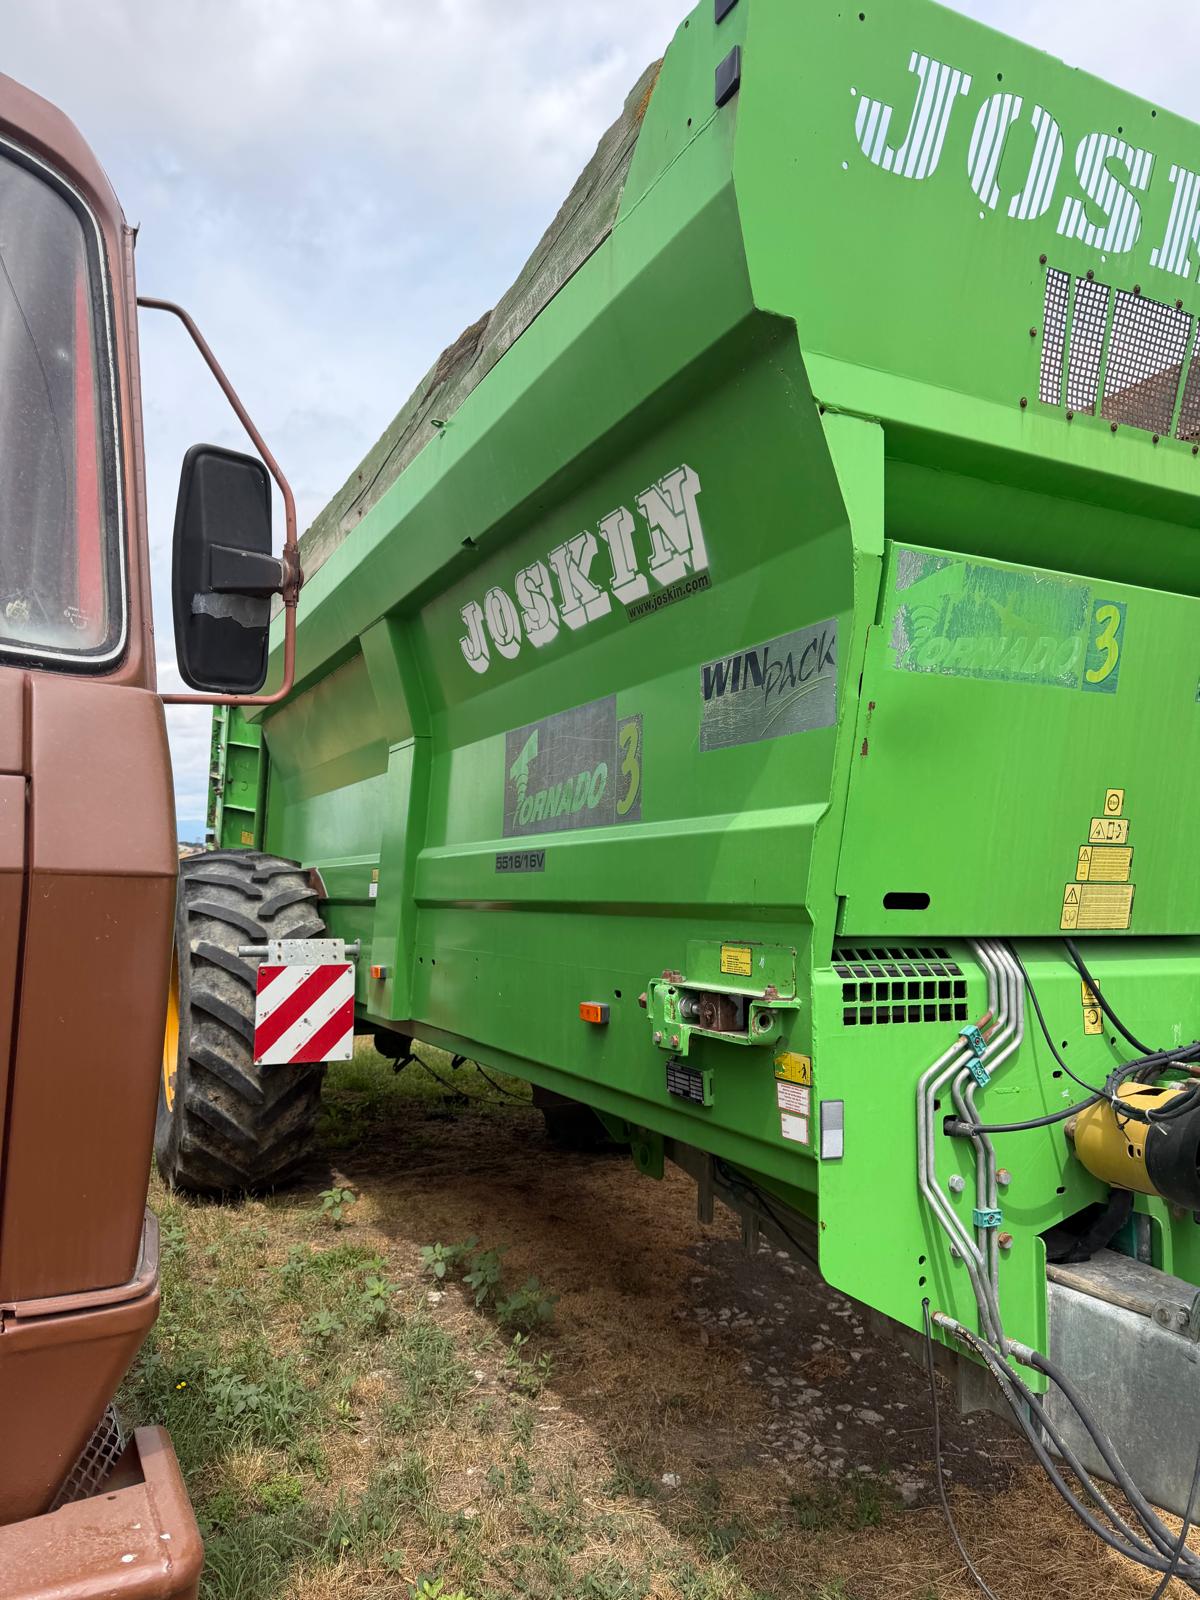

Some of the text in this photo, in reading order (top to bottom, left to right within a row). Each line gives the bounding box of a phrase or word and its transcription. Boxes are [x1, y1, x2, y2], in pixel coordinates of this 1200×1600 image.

[459, 463, 708, 674] JOSKIN
[628, 574, 709, 619] www.joskin.com
[1085, 605, 1121, 683] 3
[616, 723, 640, 815] 3
[495, 853, 544, 870] 5516/16V
